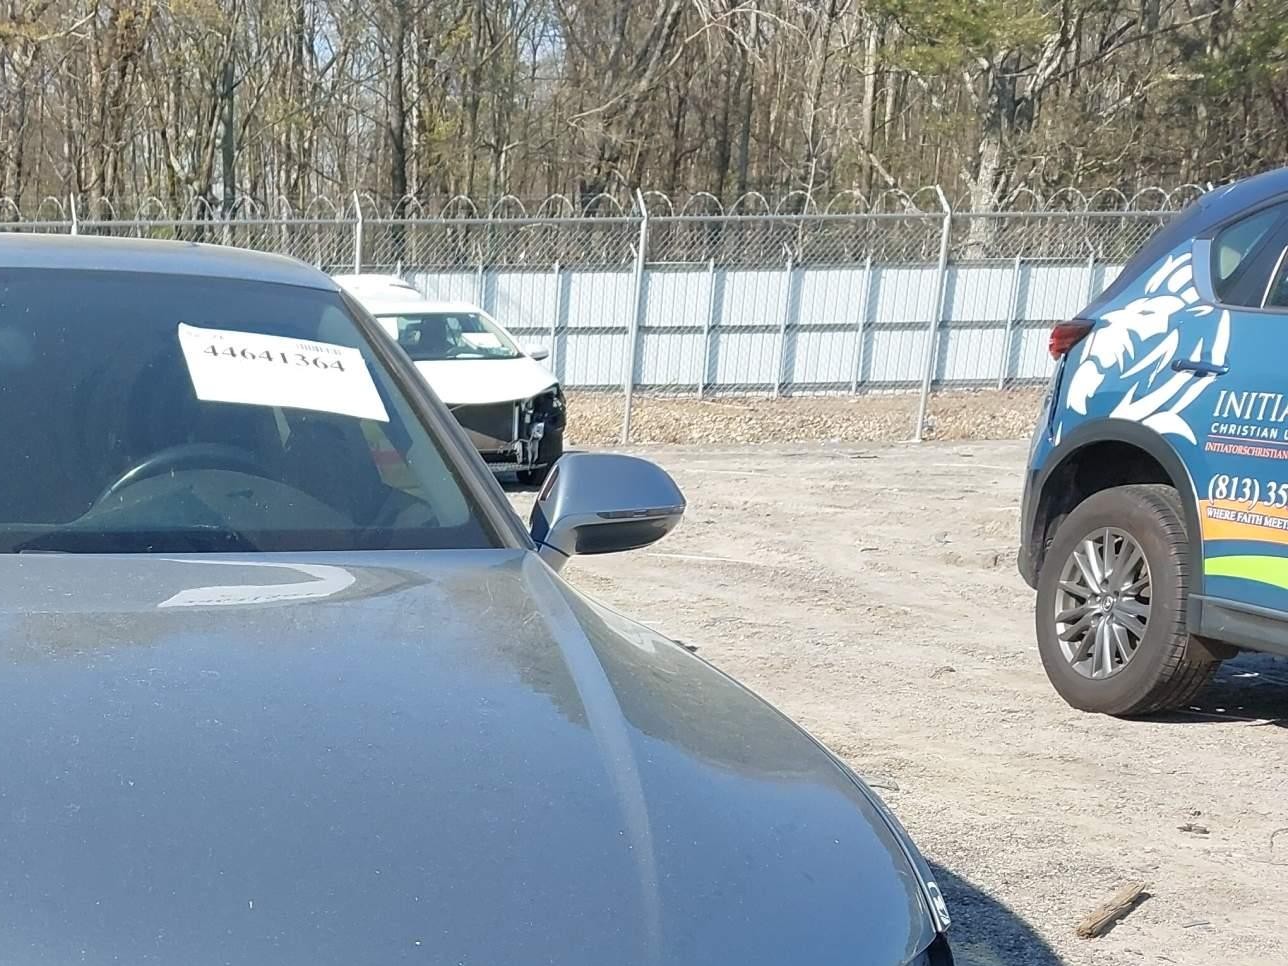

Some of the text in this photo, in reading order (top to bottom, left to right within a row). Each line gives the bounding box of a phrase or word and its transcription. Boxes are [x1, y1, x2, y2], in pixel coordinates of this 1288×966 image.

[203, 344, 346, 373] 44641364
[1211, 422, 1279, 440] CHRISTIAN
[1208, 473, 1288, 511] (813) 35
[1207, 507, 1237, 521] WHERE
[1237, 511, 1263, 525] FAITH
